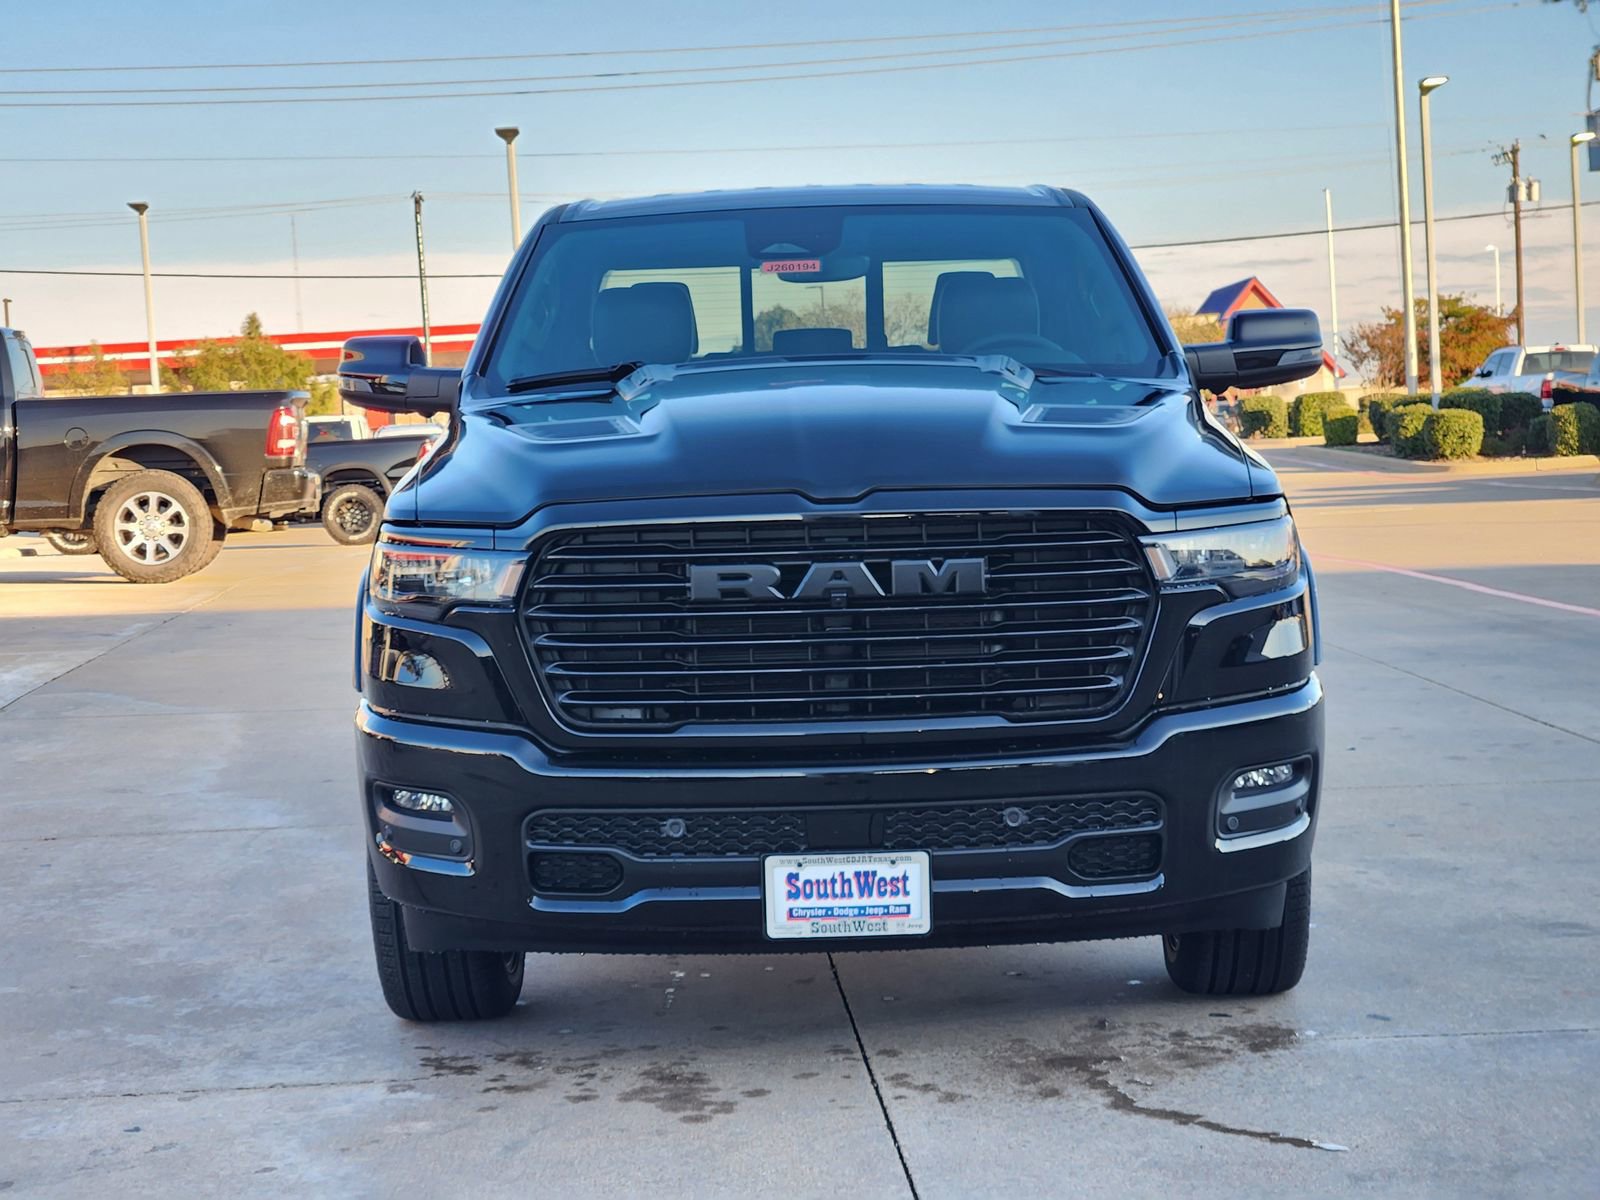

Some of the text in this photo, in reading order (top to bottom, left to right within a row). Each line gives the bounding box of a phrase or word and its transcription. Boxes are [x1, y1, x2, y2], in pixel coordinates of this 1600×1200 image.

[767, 263, 816, 272] J260194
[688, 558, 988, 601] RAM
[785, 869, 911, 901] SouthWest
[792, 904, 908, 917] Chrysler Dodge Jeep Ram
[811, 920, 889, 934] SouthWest
